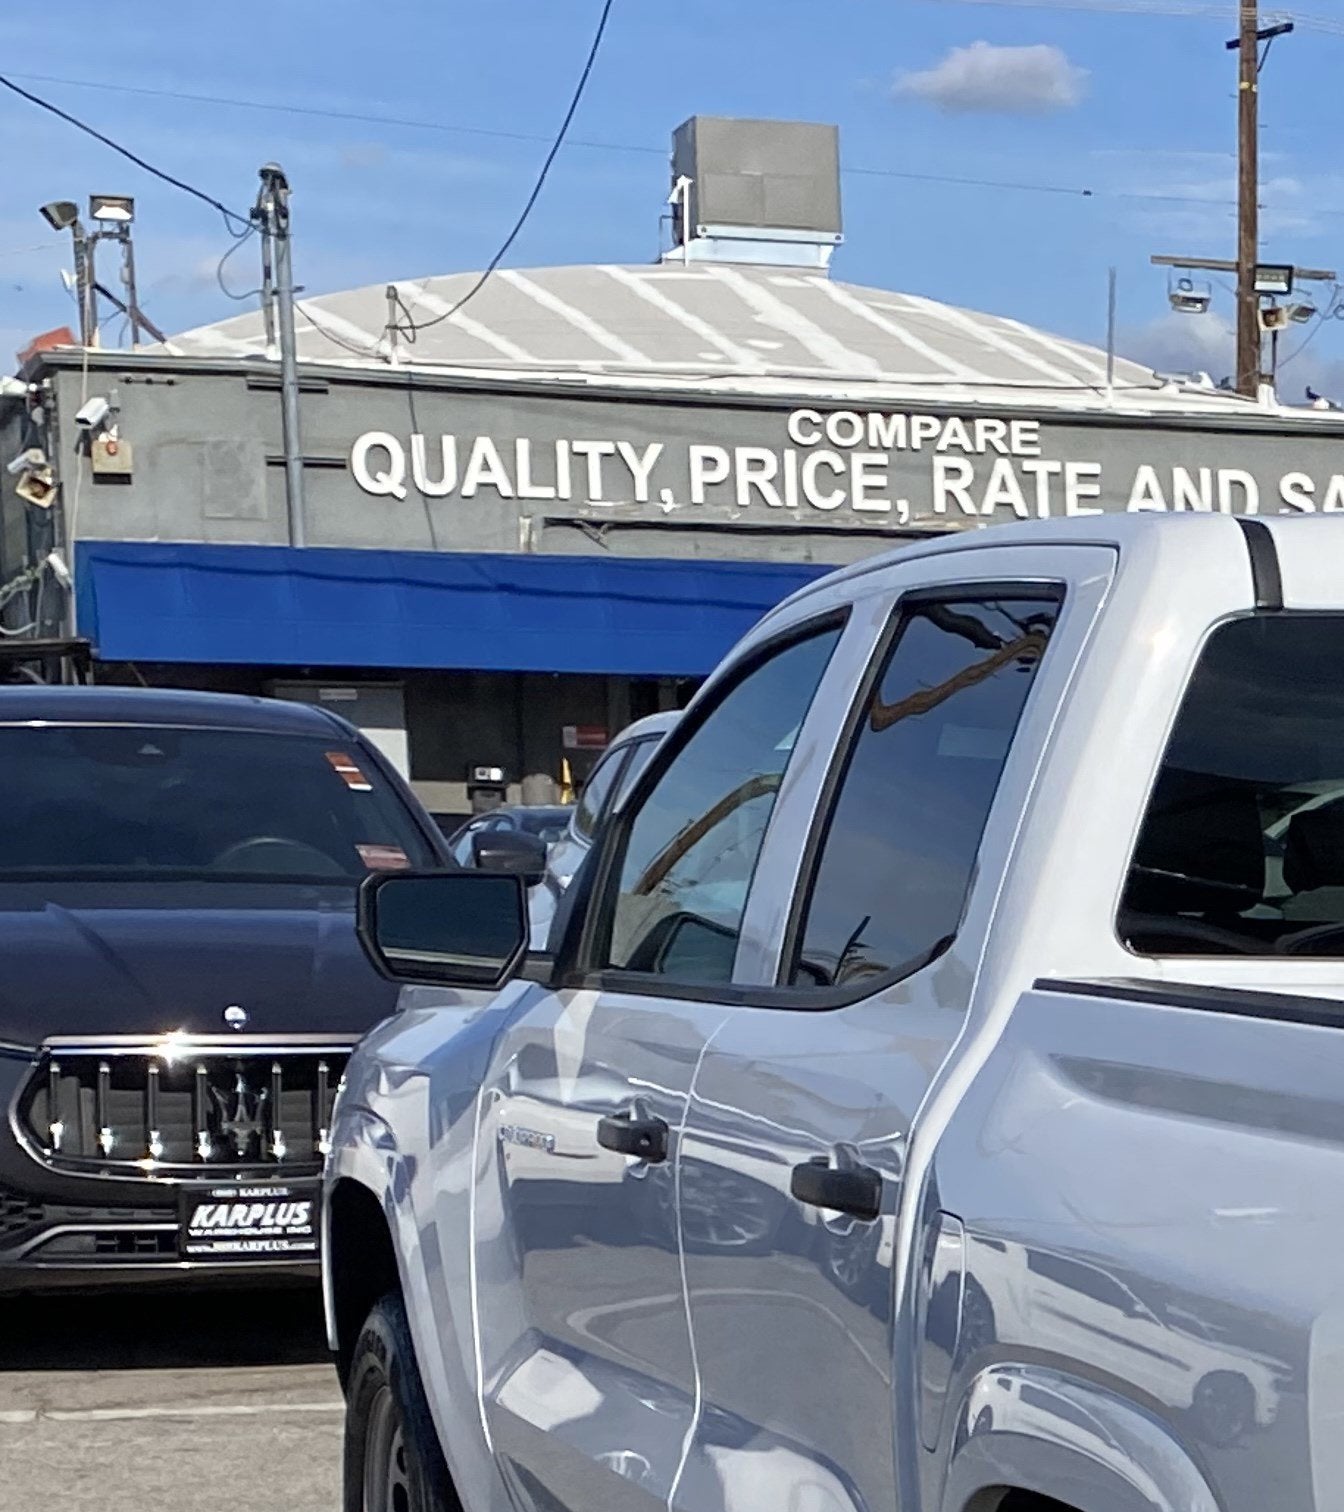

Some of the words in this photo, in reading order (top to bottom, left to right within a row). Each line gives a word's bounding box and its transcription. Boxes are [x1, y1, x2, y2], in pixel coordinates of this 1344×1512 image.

[787, 409, 1041, 457] COMPARE
[350, 431, 677, 512] QUALITY,
[689, 445, 910, 524] PRICE,
[932, 454, 1104, 519] RATE
[1126, 464, 1259, 513] AND
[190, 1201, 311, 1227] KARPLUS
